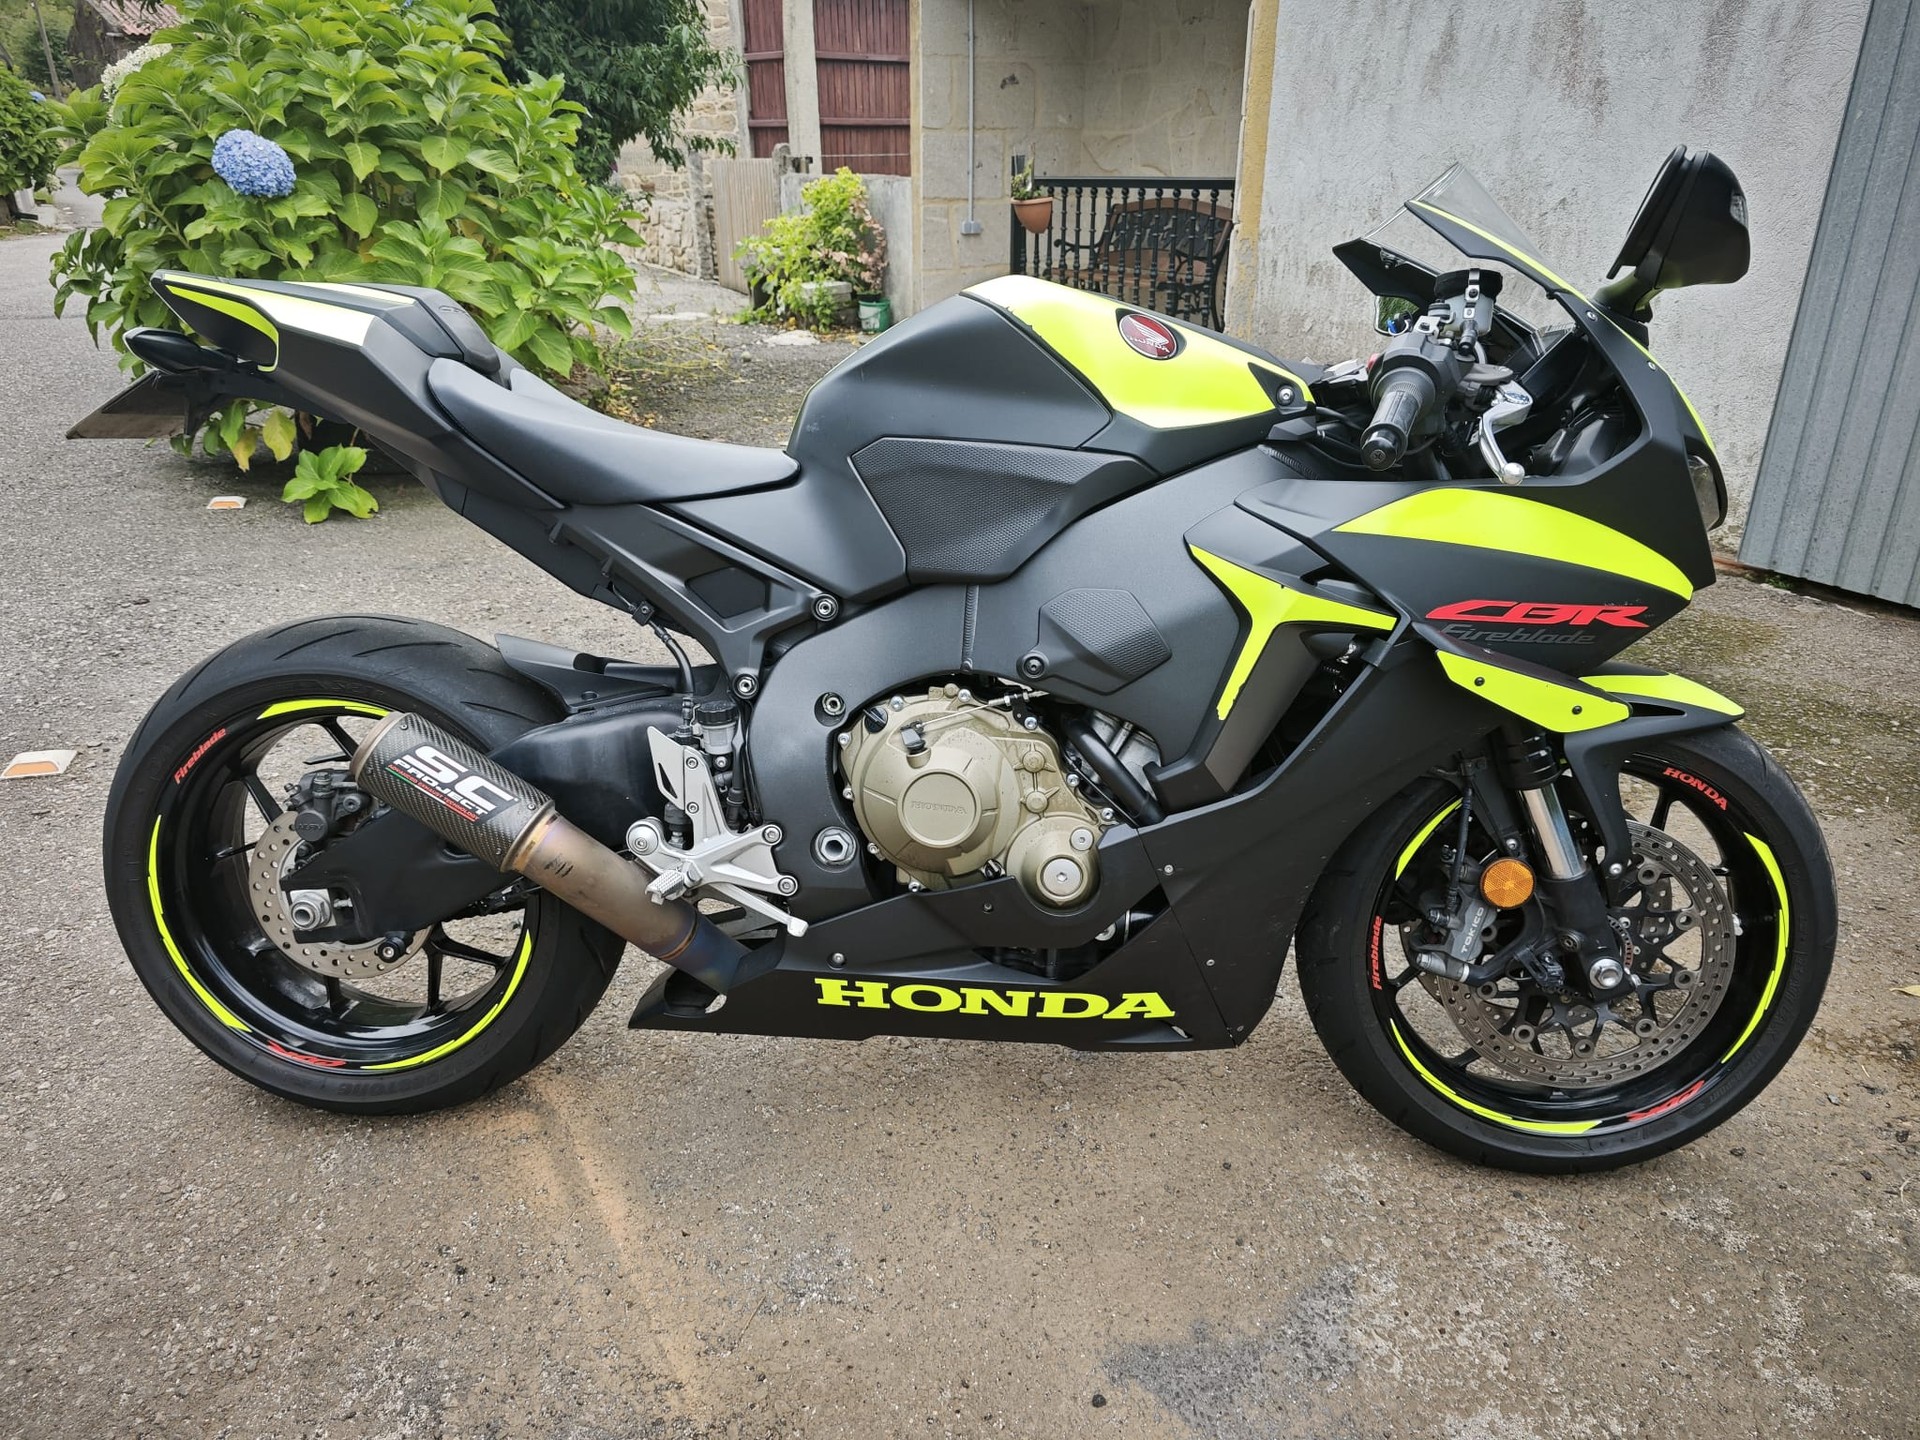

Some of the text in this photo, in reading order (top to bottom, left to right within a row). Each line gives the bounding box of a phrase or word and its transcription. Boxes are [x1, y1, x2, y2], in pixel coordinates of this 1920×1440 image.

[1425, 599, 1650, 628] CBR
[1439, 624, 1596, 645] Fireblade
[174, 728, 226, 785] Fireblade
[402, 745, 514, 812] SC
[392, 758, 488, 816] PROJECT
[1663, 766, 1728, 811] HONDA
[1370, 915, 1382, 991] Fireblade
[1461, 907, 1485, 954] TOKICO
[814, 978, 1175, 1019] HONDA
